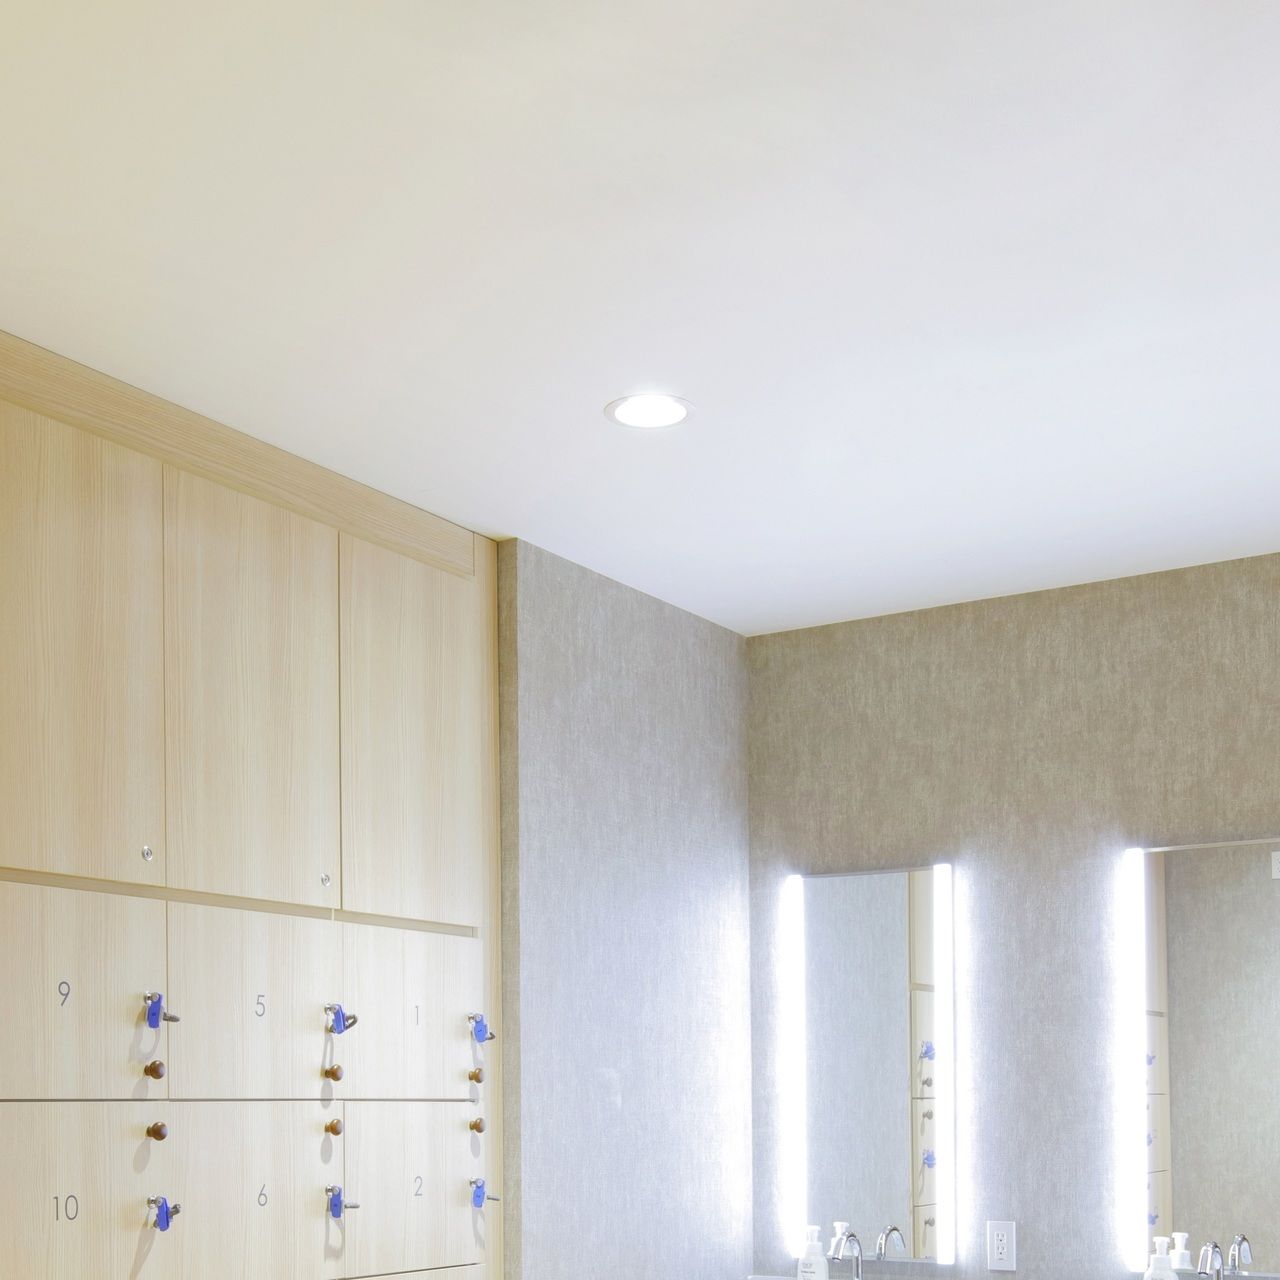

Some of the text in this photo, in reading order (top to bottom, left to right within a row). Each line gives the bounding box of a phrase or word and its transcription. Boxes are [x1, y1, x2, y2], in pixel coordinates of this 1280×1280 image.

[58, 980, 71, 1007] 9
[254, 994, 266, 1018] 5
[415, 1005, 419, 1025] 1
[257, 1183, 268, 1207] 6
[413, 1175, 423, 1197] 2
[53, 1194, 79, 1221] 10
